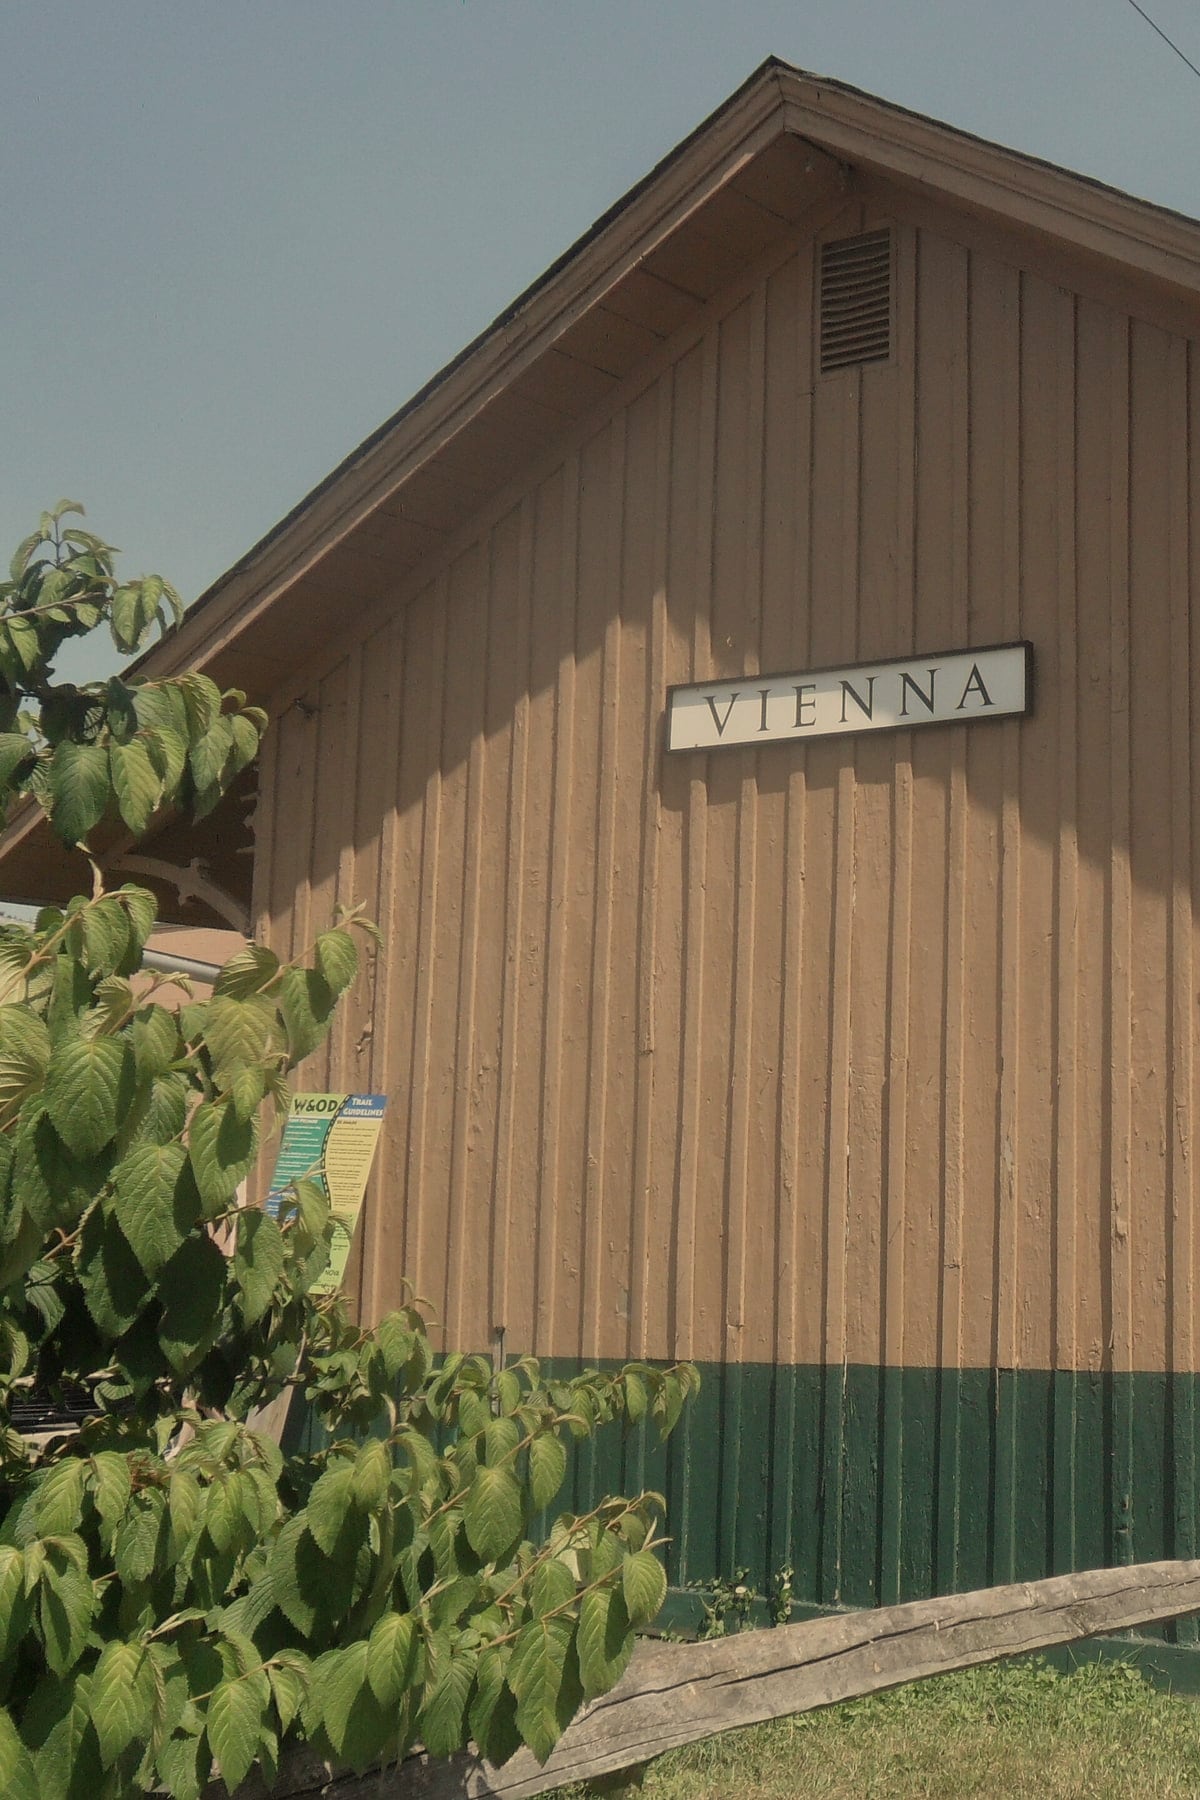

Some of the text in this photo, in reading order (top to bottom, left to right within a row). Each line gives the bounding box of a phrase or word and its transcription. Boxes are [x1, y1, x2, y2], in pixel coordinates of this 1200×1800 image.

[703, 662, 995, 737] VIENNA
[294, 1098, 338, 1112] W&OD
[343, 1107, 384, 1116] GUIDELINES
